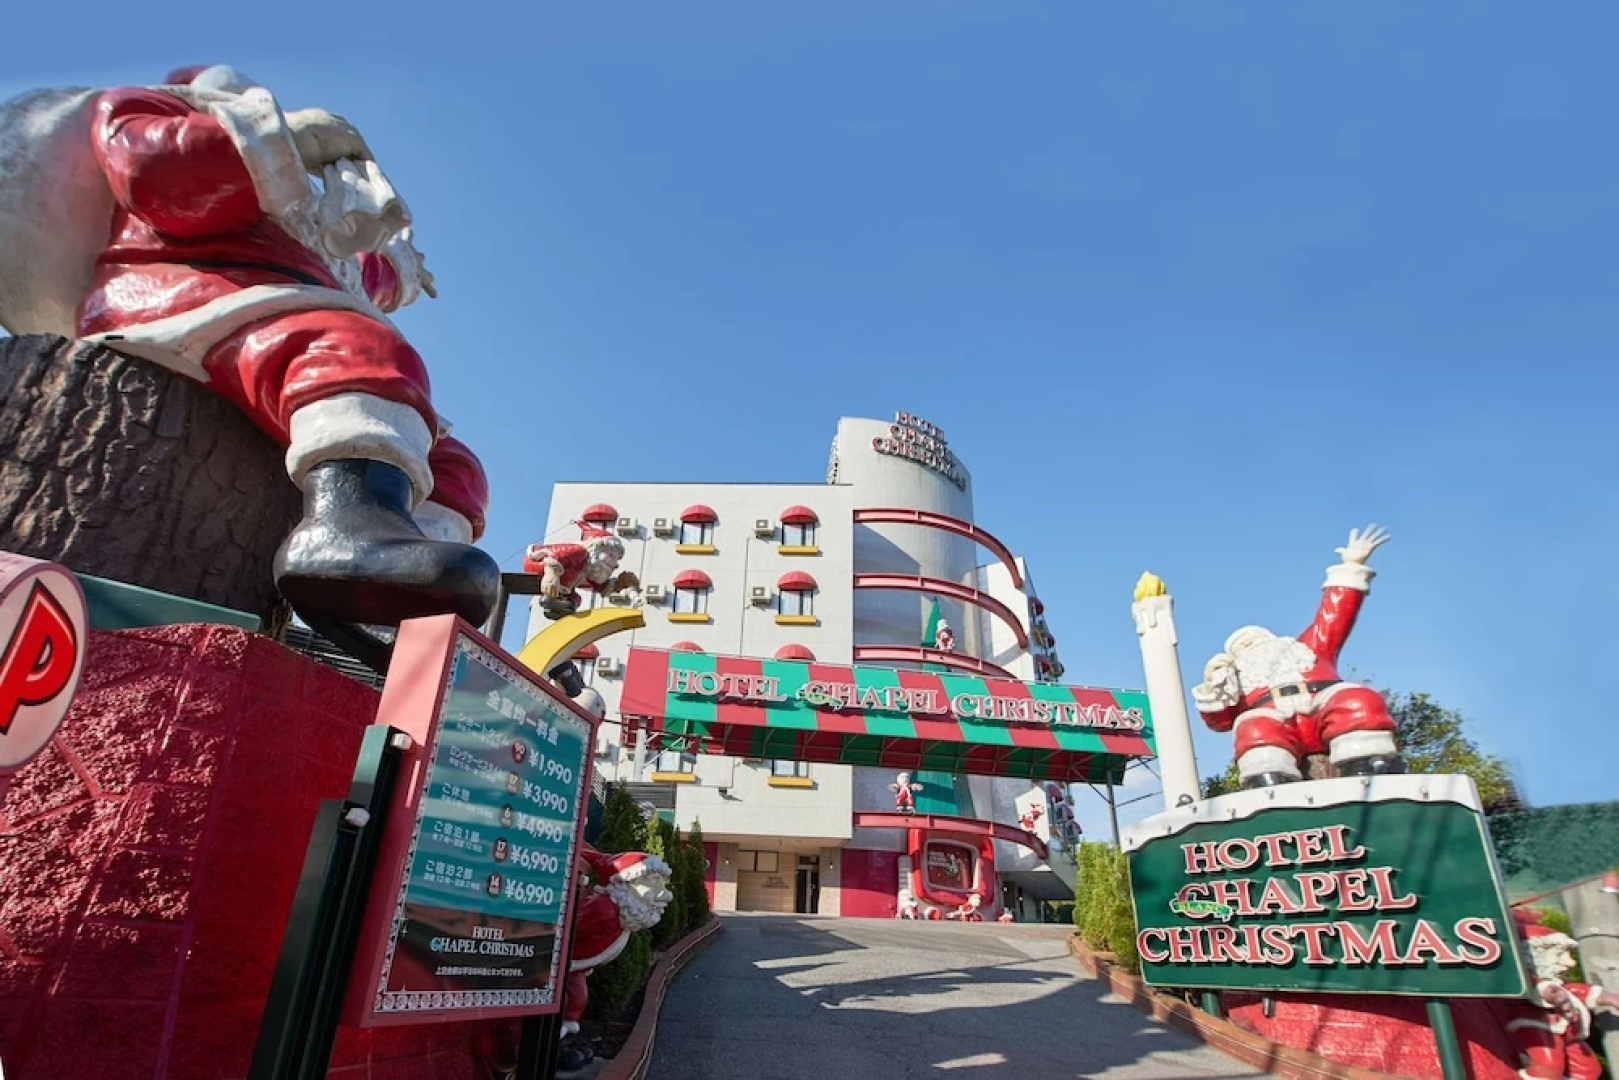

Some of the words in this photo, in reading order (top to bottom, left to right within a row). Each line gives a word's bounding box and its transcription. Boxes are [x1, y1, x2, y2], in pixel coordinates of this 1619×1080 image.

[0, 577, 77, 735] P
[667, 668, 787, 702] HOTEL
[800, 680, 947, 715] CHAPEL
[952, 693, 1144, 731] CHRISTMAS
[528, 748, 572, 785] ¥1,990
[522, 780, 568, 814] ¥3,990
[515, 811, 563, 843] ¥4,990
[509, 844, 558, 874] ¥6,990
[1180, 824, 1365, 874] HOTEL
[504, 878, 554, 906] ¥6,990
[1174, 866, 1417, 920] CHAPEL
[430, 937, 478, 954] CHAPEL
[479, 941, 535, 958] CHRISTMAS
[472, 926, 505, 942] HOTEL
[1136, 917, 1502, 967] CHRISTMAS
